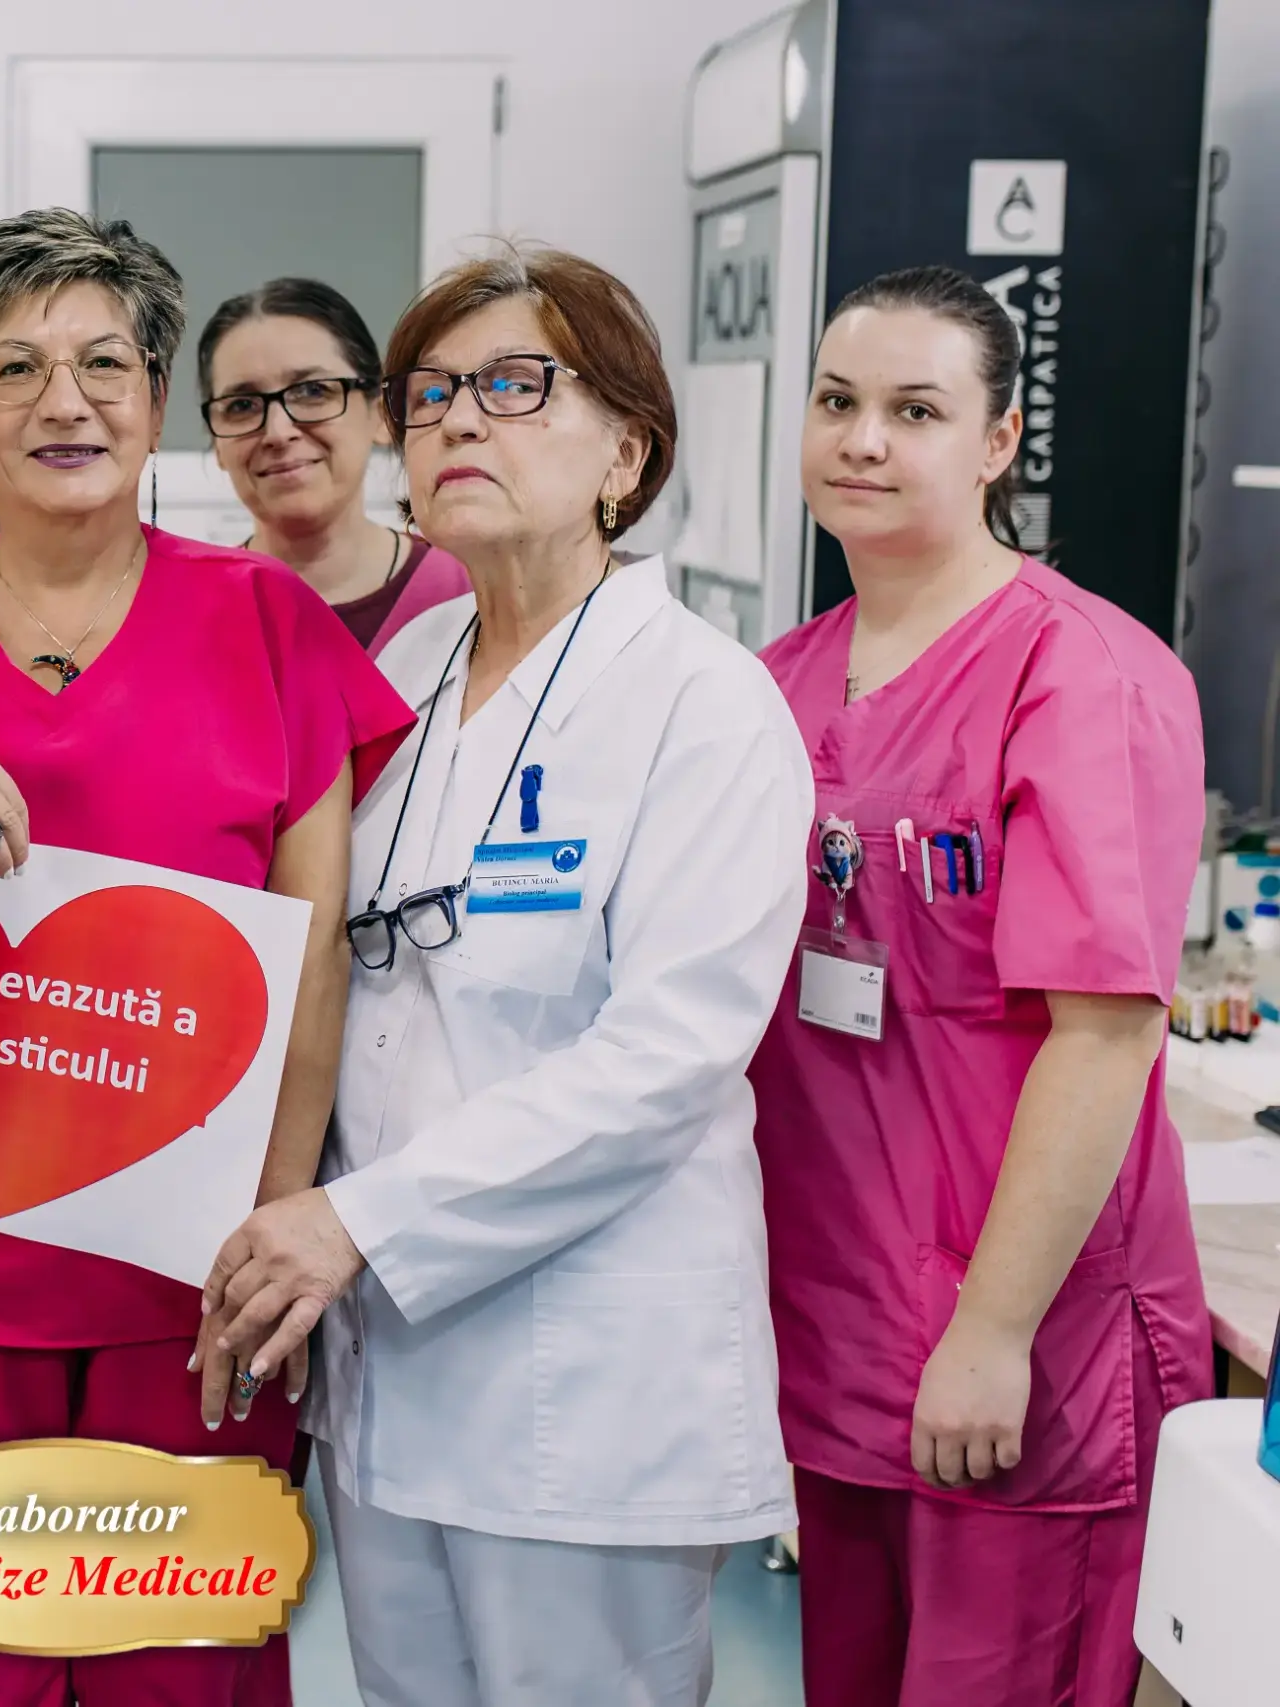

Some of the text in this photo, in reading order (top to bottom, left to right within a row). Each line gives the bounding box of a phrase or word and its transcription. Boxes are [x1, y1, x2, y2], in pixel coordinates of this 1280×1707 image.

[1025, 265, 1062, 483] CARPATICA
[531, 877, 559, 885] MARIA
[173, 1006, 198, 1037] a
